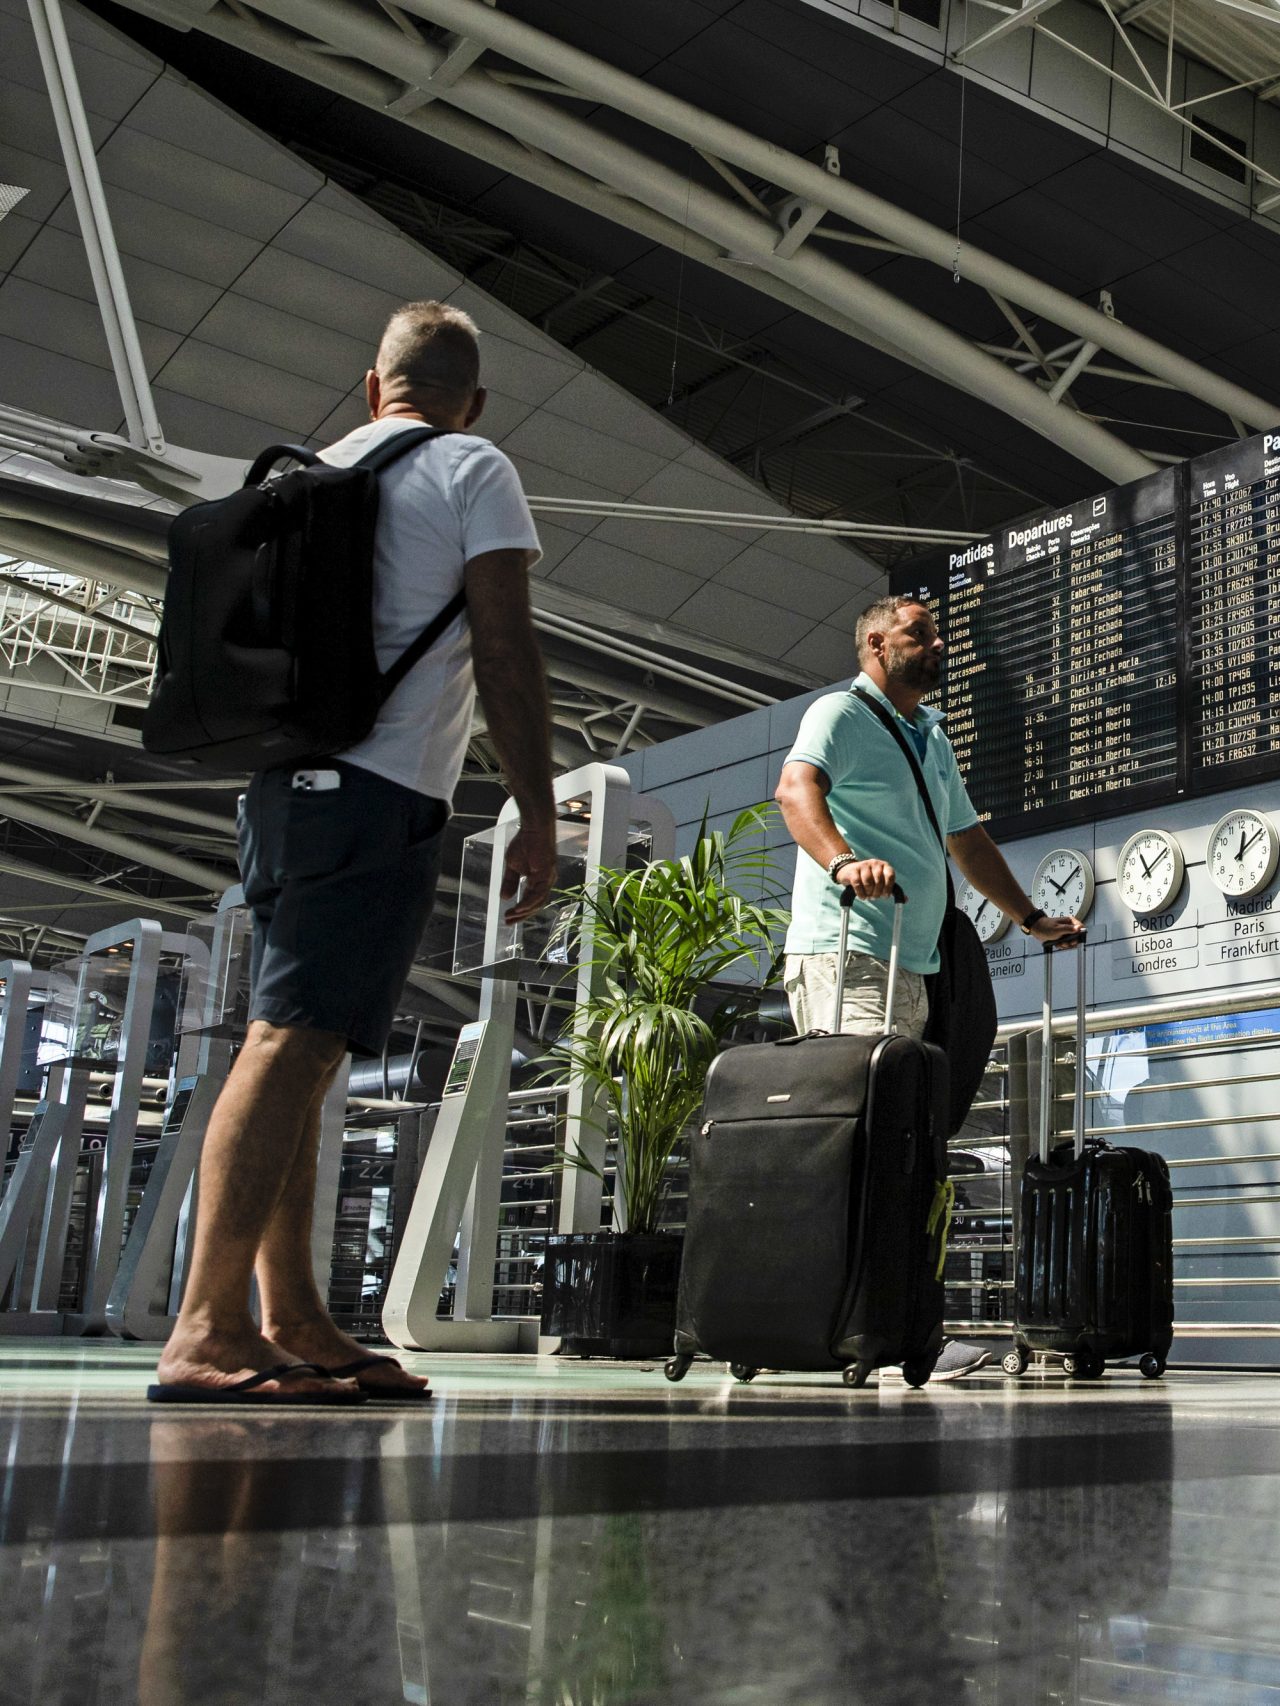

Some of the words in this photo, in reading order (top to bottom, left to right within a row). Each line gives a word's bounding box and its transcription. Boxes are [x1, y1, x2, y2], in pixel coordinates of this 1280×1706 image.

[1224, 479, 1239, 490] Flight
[1203, 489, 1216, 498] Time
[1199, 496, 1220, 512] 12:40
[1199, 510, 1221, 527] 12:45
[949, 542, 994, 570] Partidas
[1008, 513, 1073, 548] Departures
[1199, 525, 1221, 542] 12:55
[1071, 543, 1090, 558] Porta
[1094, 532, 1122, 550] Fechada
[1200, 540, 1221, 556] 12:55
[1200, 554, 1221, 571] 13:00
[948, 614, 969, 629] Vienna
[1070, 567, 1102, 586] Atrasado
[1154, 542, 1175, 558] 12:55
[1200, 569, 1221, 586] 13:10
[948, 627, 969, 642] Lisboa
[1070, 581, 1102, 600] Embarque
[1154, 557, 1175, 572] 11:30
[1200, 584, 1222, 600] 13:20
[1200, 599, 1222, 615] 13:20
[1200, 614, 1222, 630] 13:25
[1200, 629, 1222, 645] 13:25
[948, 651, 976, 668] Alicante
[1201, 644, 1222, 660] 13:35
[948, 661, 986, 682] Carcassonne
[1201, 659, 1223, 675] 13:45
[947, 681, 968, 695] Madrid
[1201, 675, 1223, 690] 14:00
[1070, 696, 1101, 714] Previsto
[1155, 675, 1175, 690] 12:15
[1201, 690, 1223, 706] 14:00
[947, 719, 974, 736] Istanbul
[1070, 681, 1101, 699] Check-in
[1106, 671, 1134, 688] Fechado
[947, 706, 971, 722] Genebra
[1070, 710, 1101, 728] Check-in
[1106, 701, 1130, 717] Aberto
[1201, 705, 1223, 721] 14:15
[1201, 721, 1224, 736] 14:20
[1202, 736, 1224, 752] 14:20
[1202, 752, 1224, 767] 14:25
[1226, 896, 1273, 917] Madrid
[1133, 914, 1175, 934] PORTO
[1234, 919, 1265, 936] Paris
[985, 945, 1012, 959] Paulo
[1135, 936, 1173, 954] Lisboa
[1221, 938, 1280, 960] Frankfurt
[990, 963, 1022, 977] aneiro
[1131, 957, 1177, 974] Londres
[359, 1160, 385, 1180] 22
